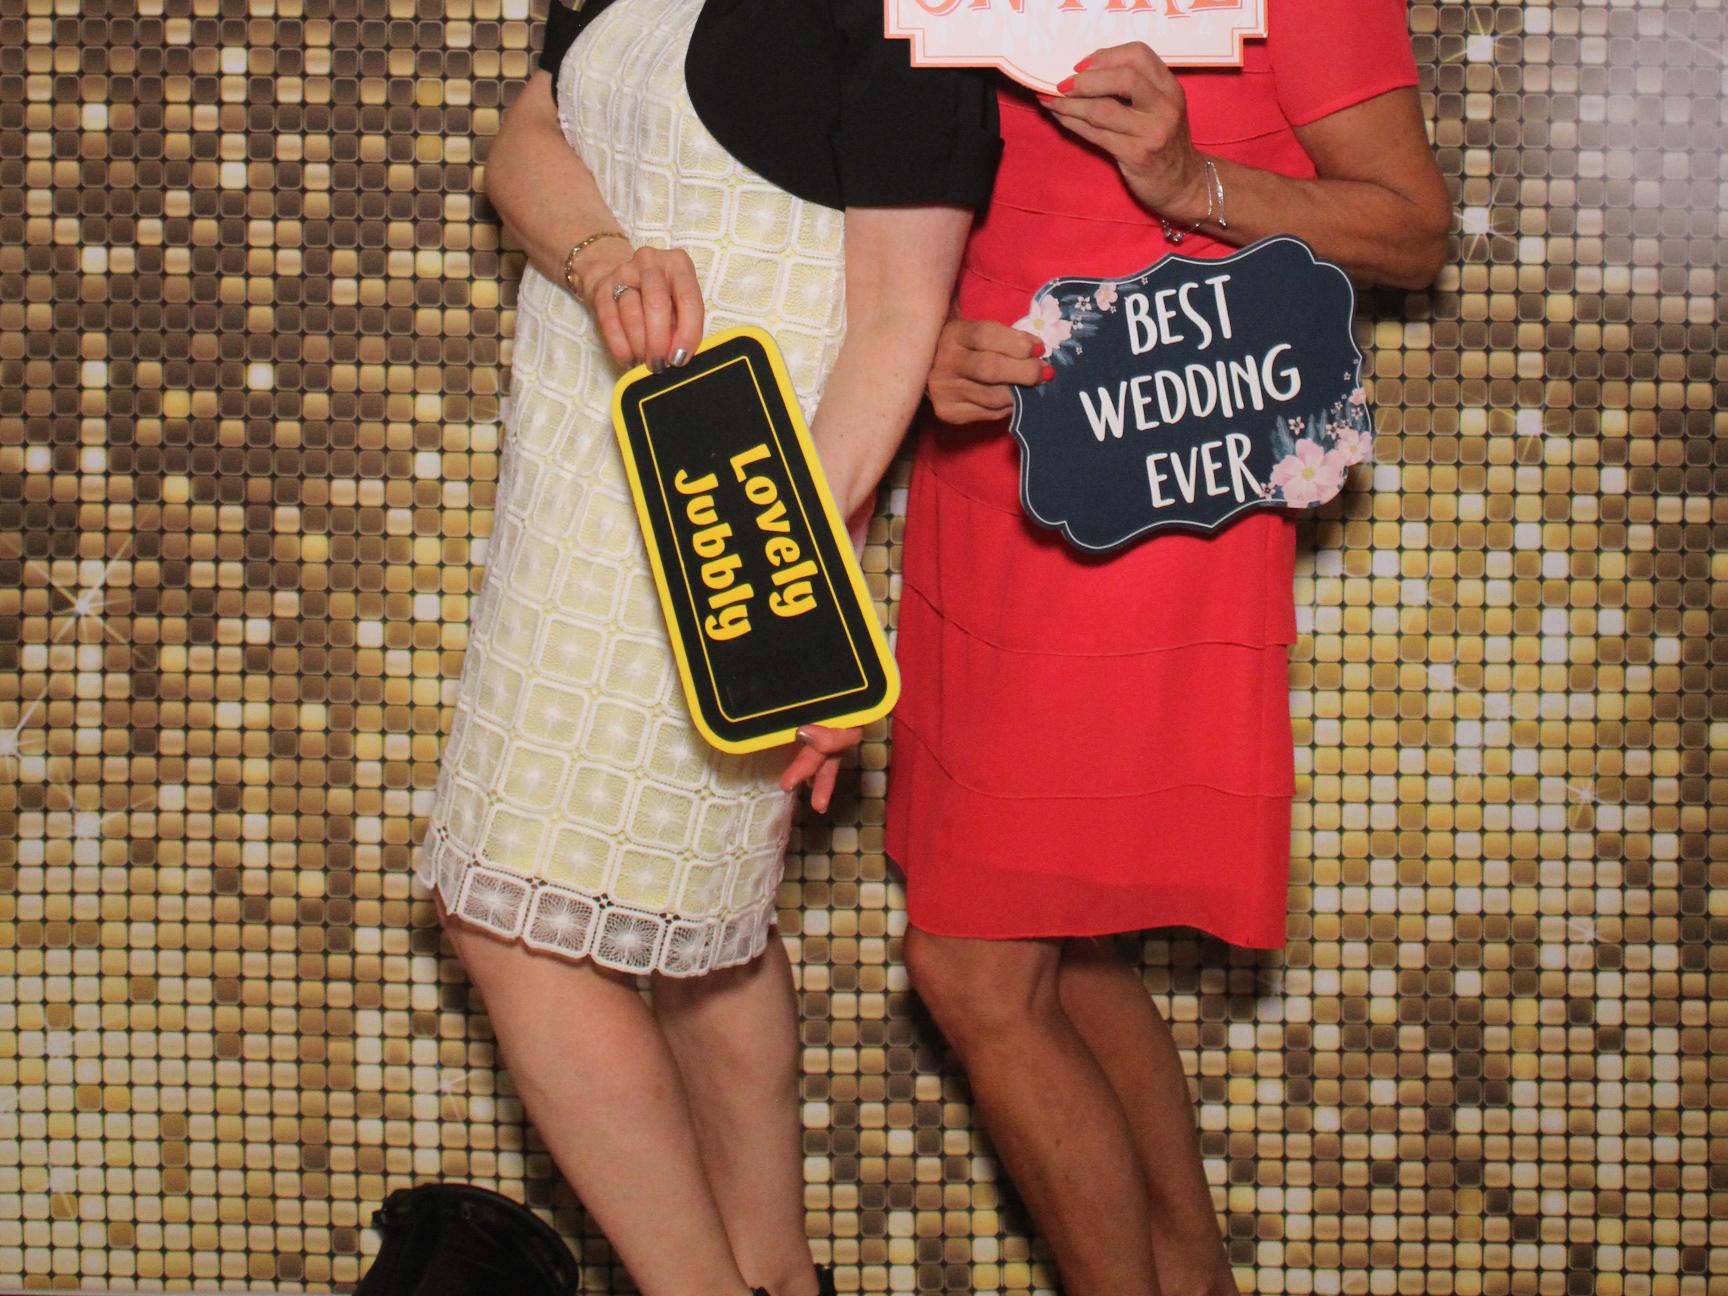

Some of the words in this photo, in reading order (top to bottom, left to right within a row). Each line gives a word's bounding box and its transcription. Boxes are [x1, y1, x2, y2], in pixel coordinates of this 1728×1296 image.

[1125, 274, 1231, 356] BEST
[1079, 343, 1302, 442] WEDDING
[1145, 433, 1263, 508] EVER
[674, 468, 754, 642] Jubbly
[729, 443, 819, 618] Lovely
